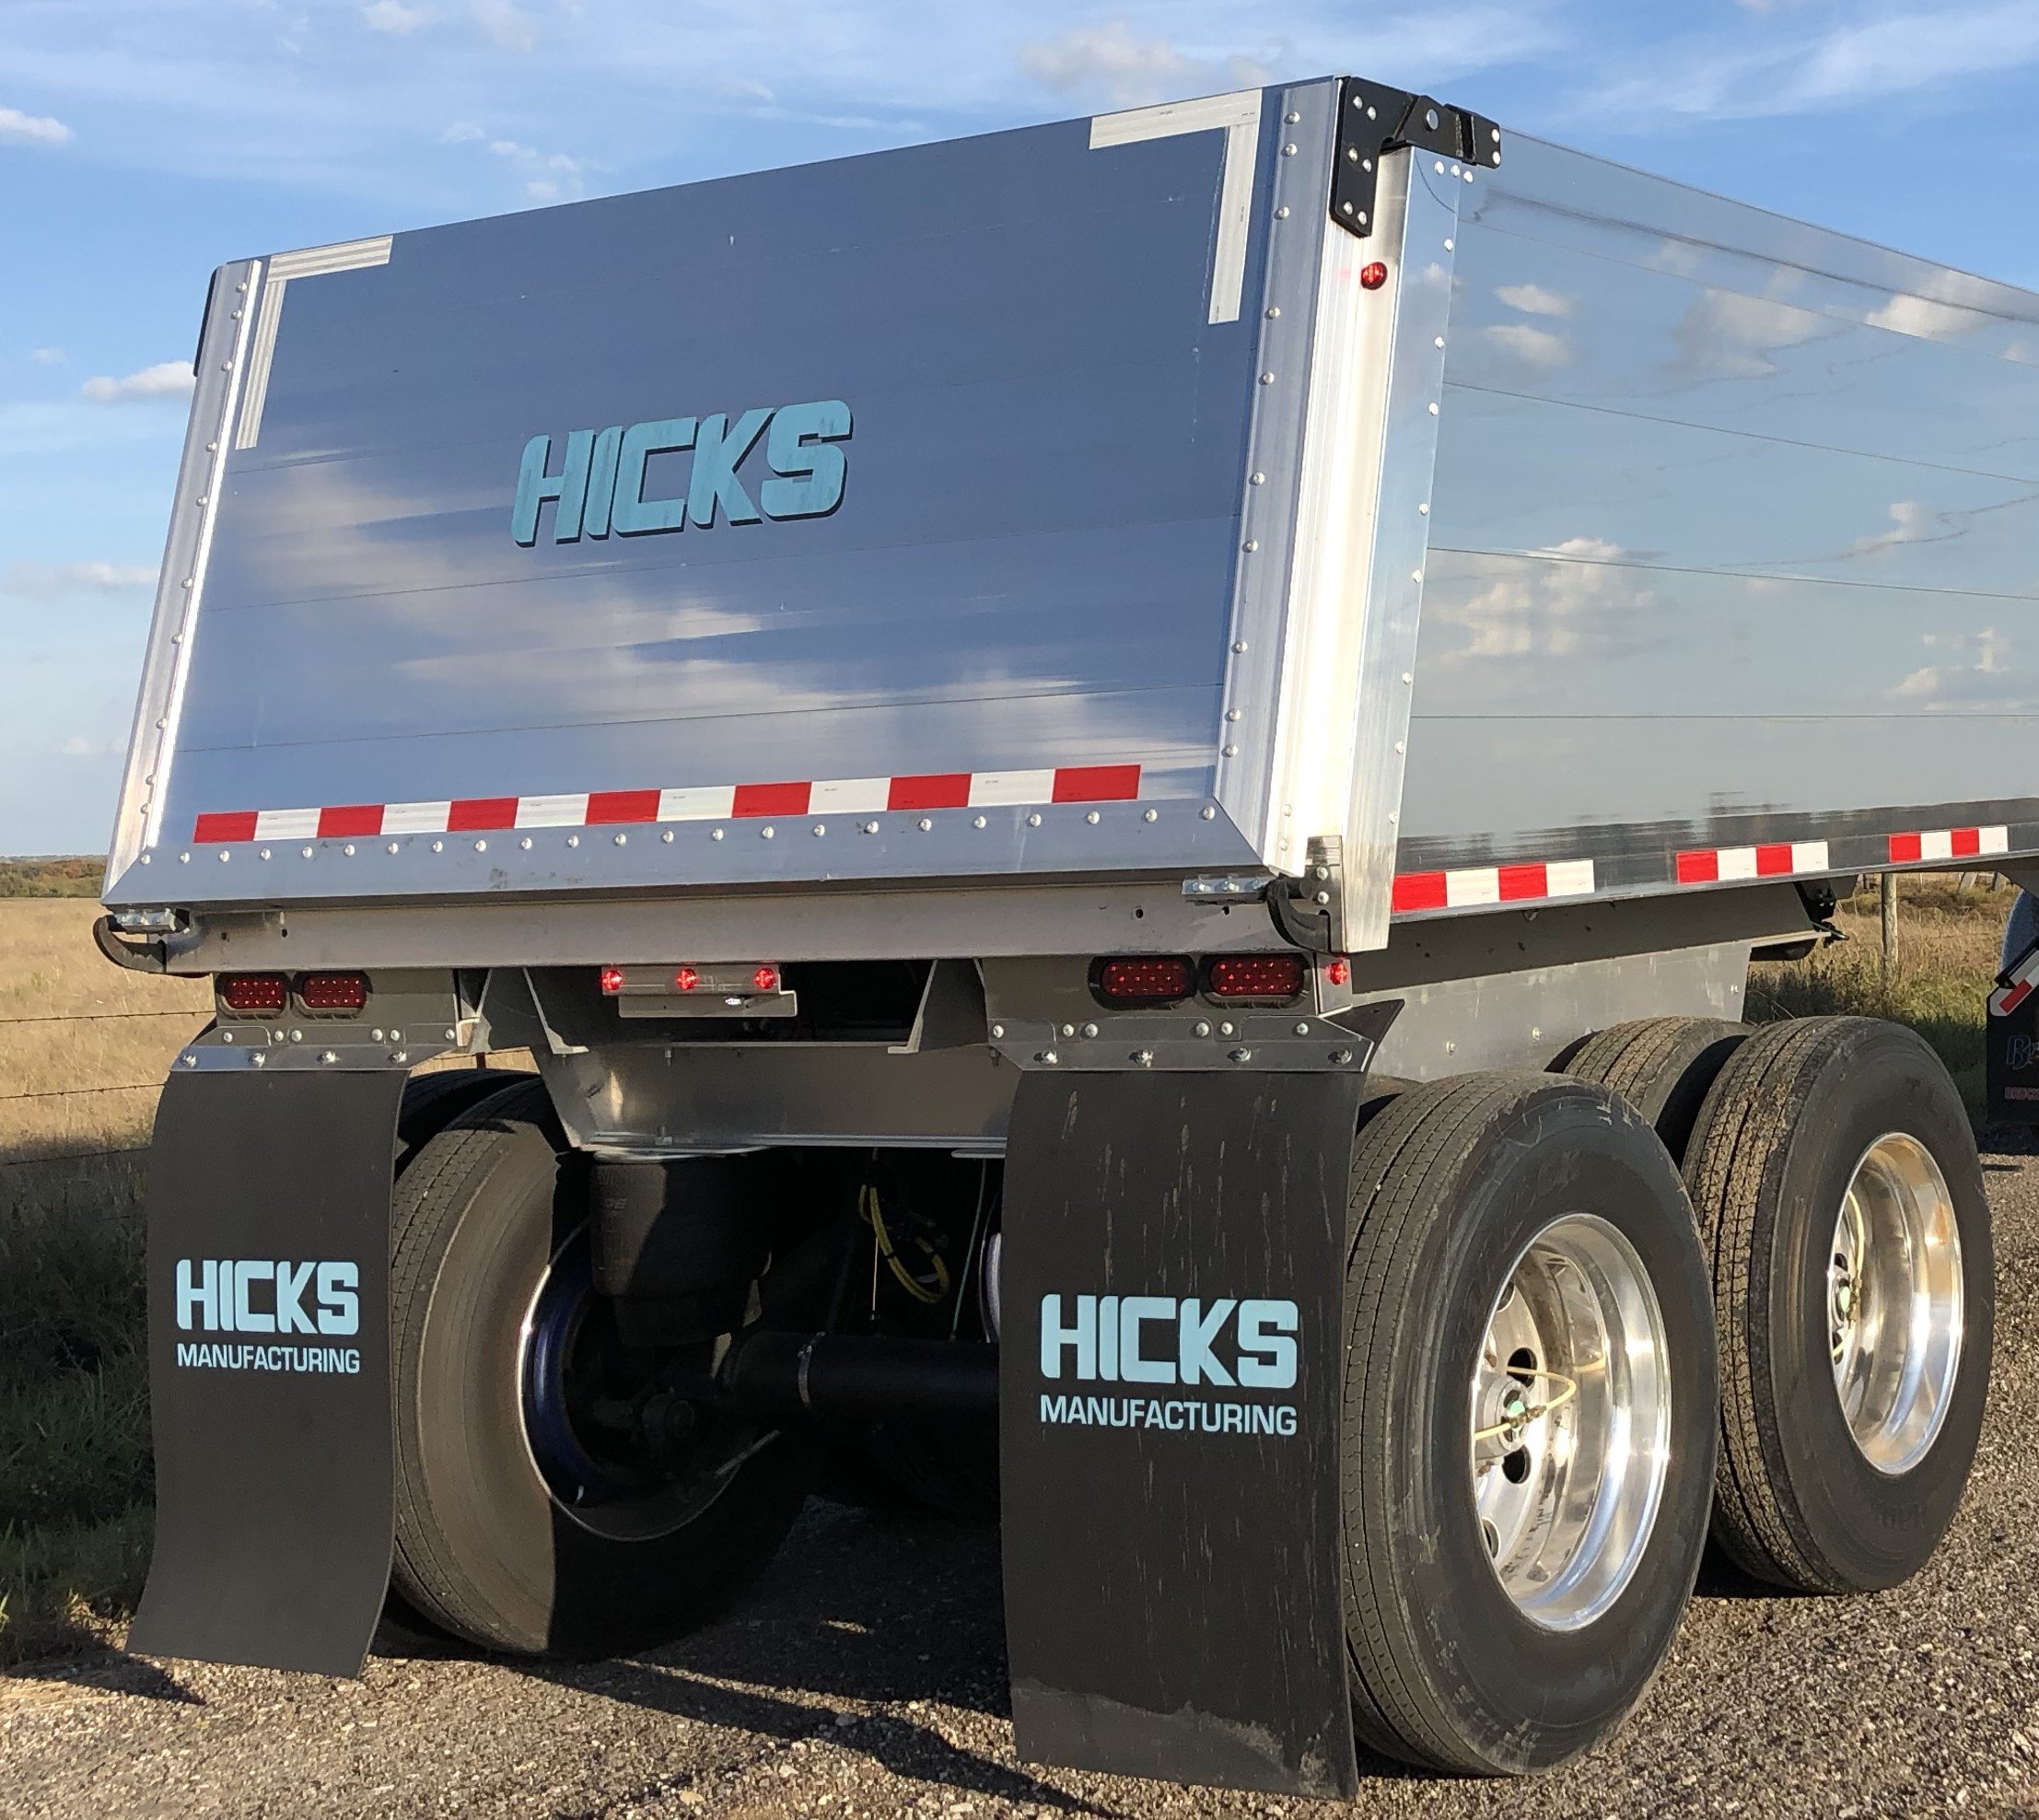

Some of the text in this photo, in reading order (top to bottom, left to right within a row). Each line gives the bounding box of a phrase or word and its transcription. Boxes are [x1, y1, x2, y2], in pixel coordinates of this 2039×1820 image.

[511, 400, 854, 548] HICKS
[177, 1259, 359, 1335] HICKS
[177, 1343, 360, 1373] MANUFACTURING
[1041, 1293, 1299, 1389] HICKS
[1040, 1394, 1298, 1435] MANUFACTURING
